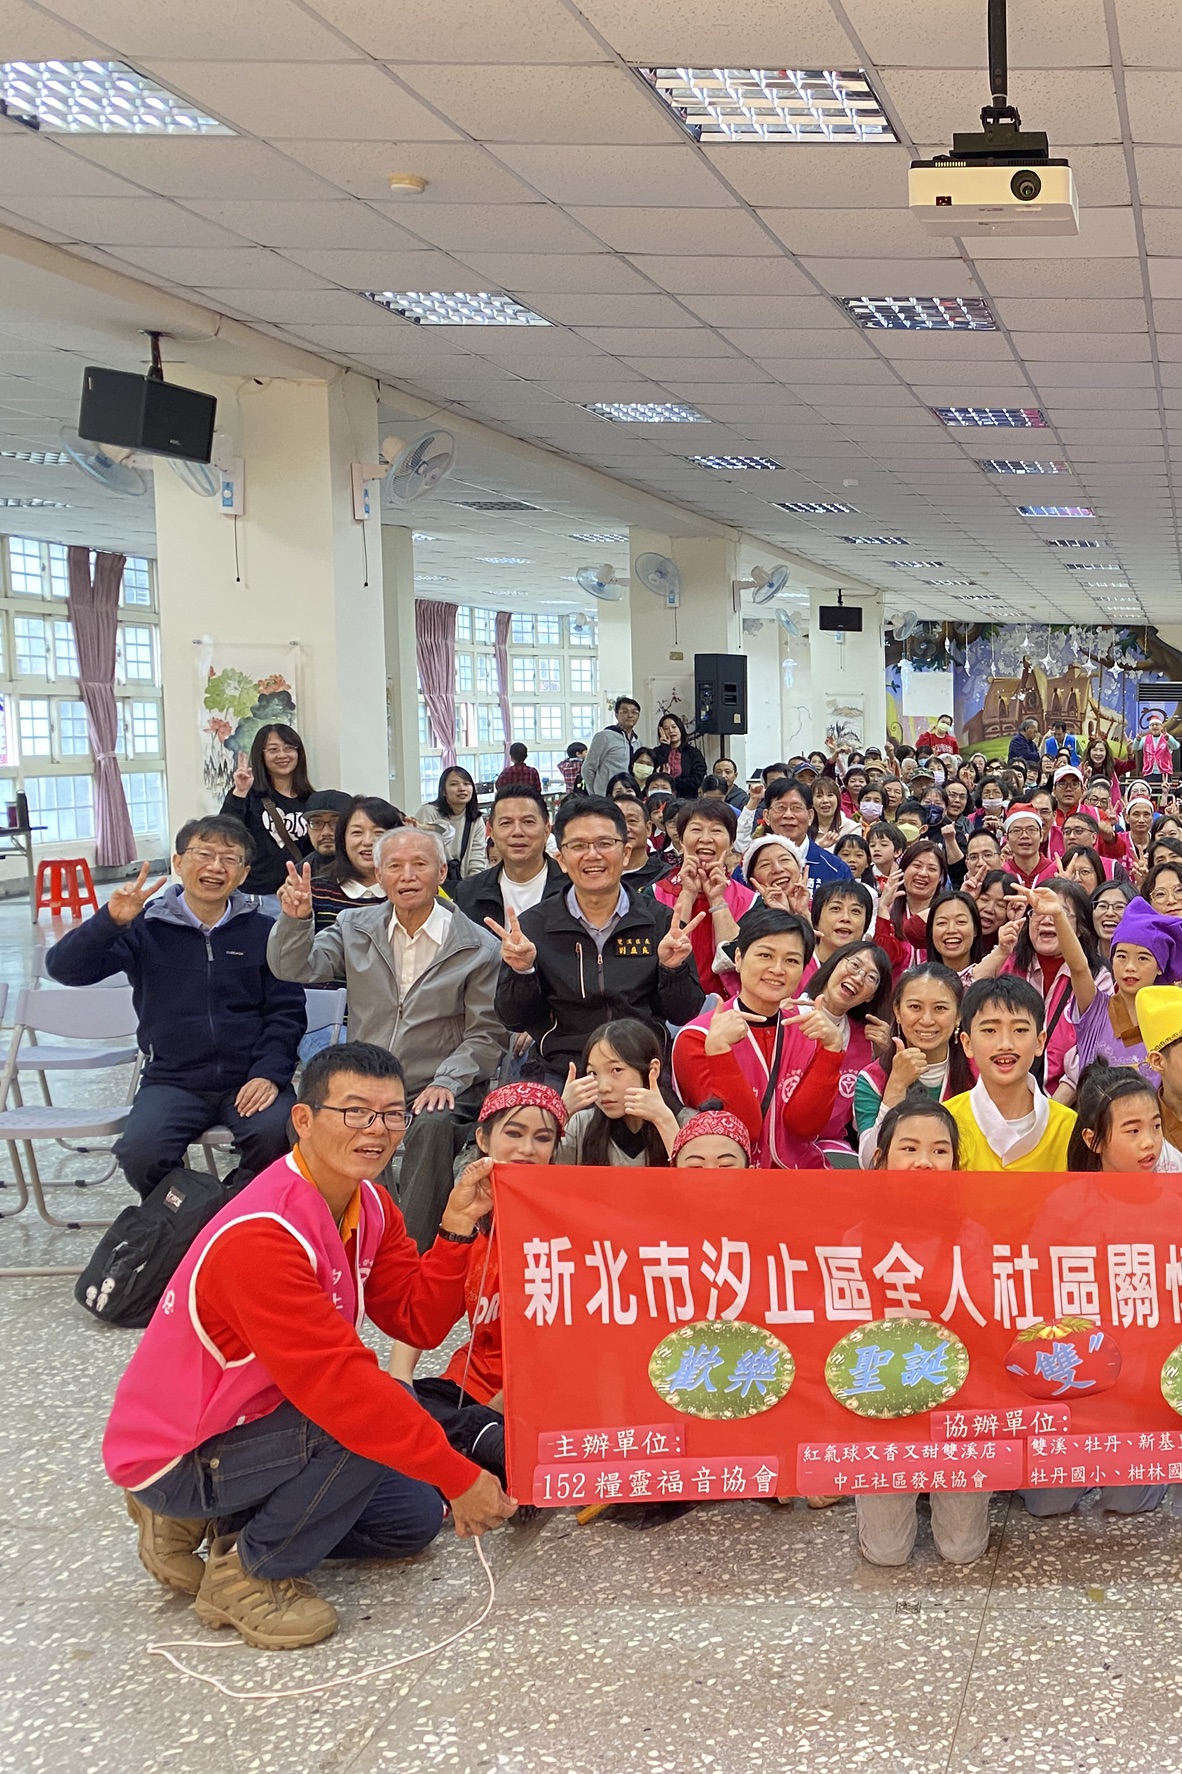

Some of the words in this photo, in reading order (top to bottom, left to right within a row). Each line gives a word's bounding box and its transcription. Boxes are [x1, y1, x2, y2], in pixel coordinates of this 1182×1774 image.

[665, 1343, 780, 1398] 歡樂
[844, 1340, 951, 1397] 聖誕
[833, 1468, 988, 1492] 中正社區發展協會
